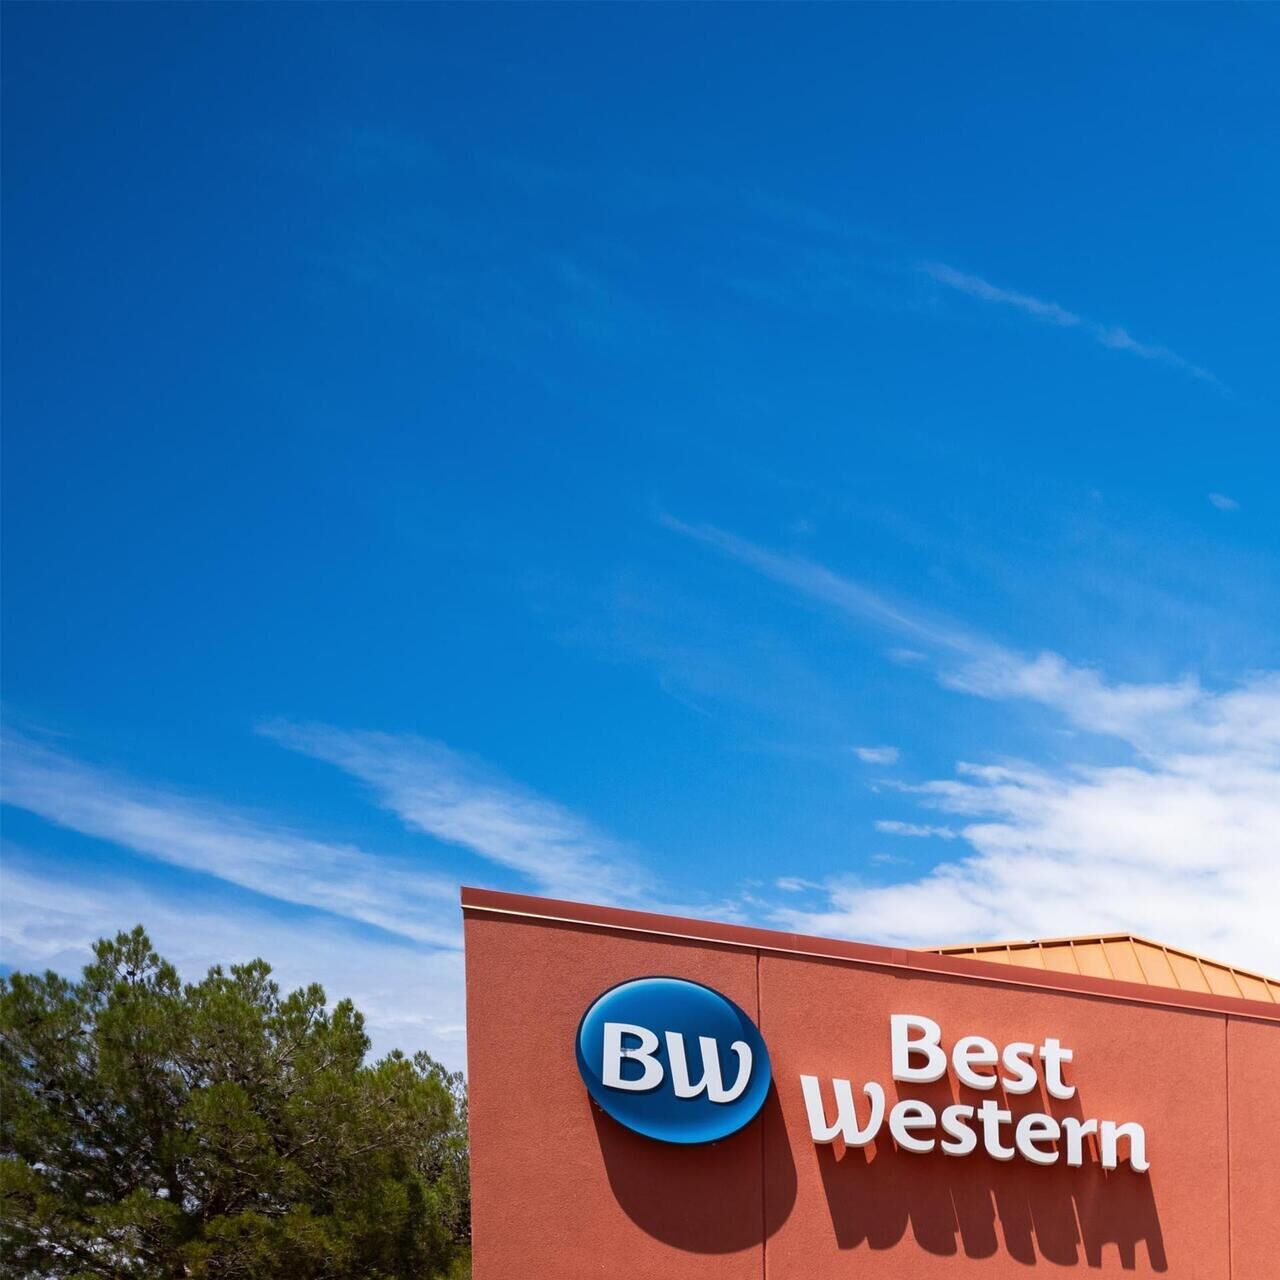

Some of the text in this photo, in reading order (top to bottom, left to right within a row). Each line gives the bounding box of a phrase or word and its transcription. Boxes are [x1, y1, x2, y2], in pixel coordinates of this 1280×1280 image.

[602, 1022, 753, 1103] BW
[890, 1013, 1076, 1099] Best
[800, 1074, 1151, 1172] Western
